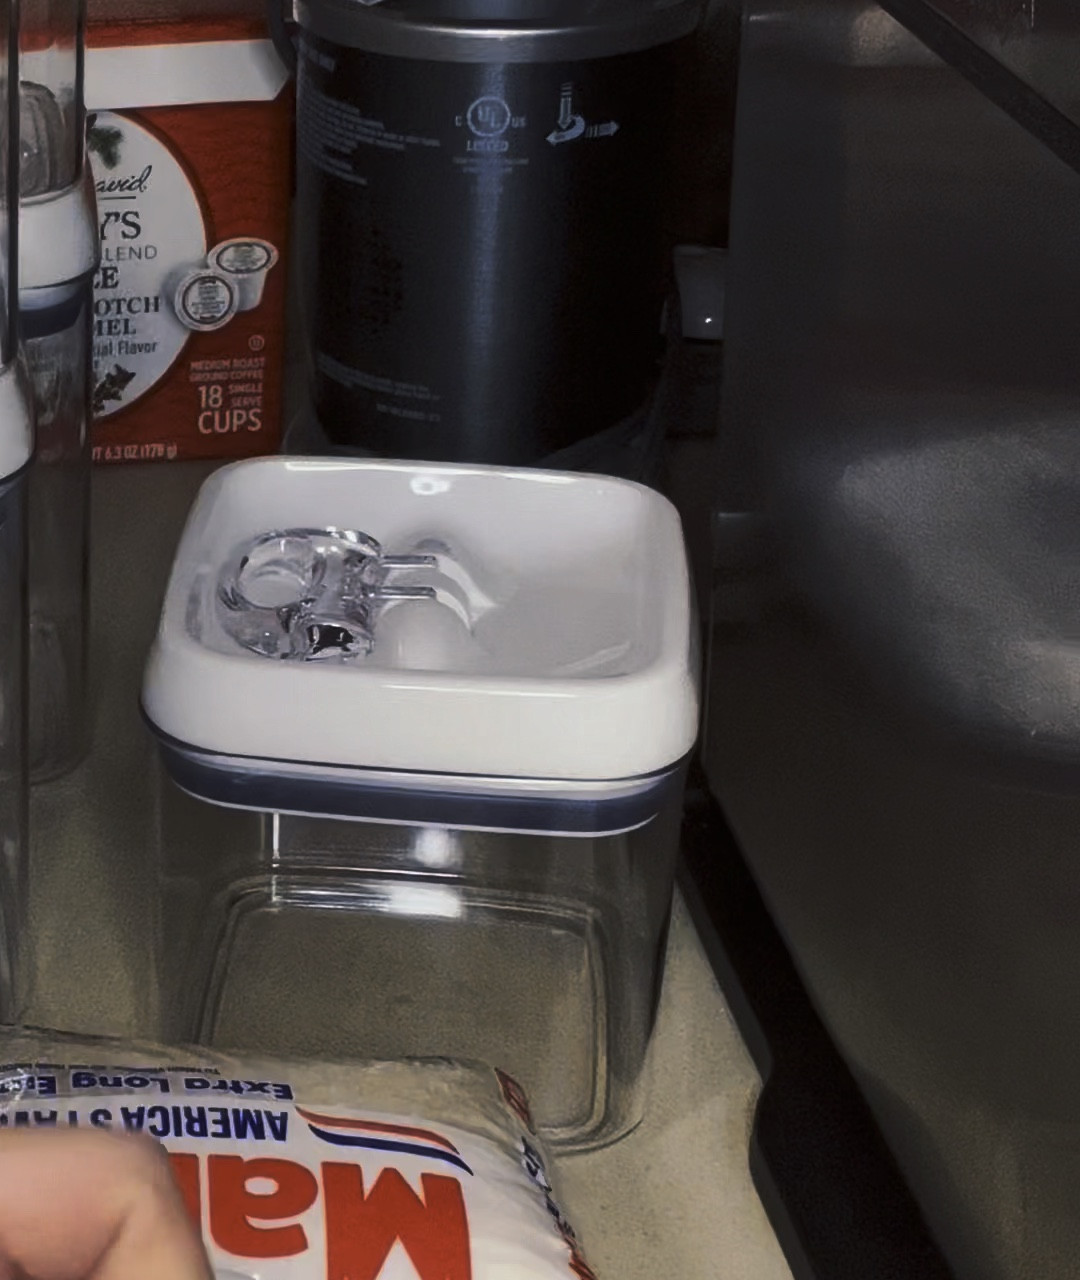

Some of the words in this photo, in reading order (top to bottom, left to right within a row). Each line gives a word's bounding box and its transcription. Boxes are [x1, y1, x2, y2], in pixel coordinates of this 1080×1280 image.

[96, 164, 152, 193] avid
[101, 245, 158, 263] LEND
[94, 266, 119, 290] E
[198, 385, 223, 409] 18
[198, 408, 262, 435] CUPS
[71, 1071, 170, 1094] Long
[183, 1075, 294, 1101] Extra
